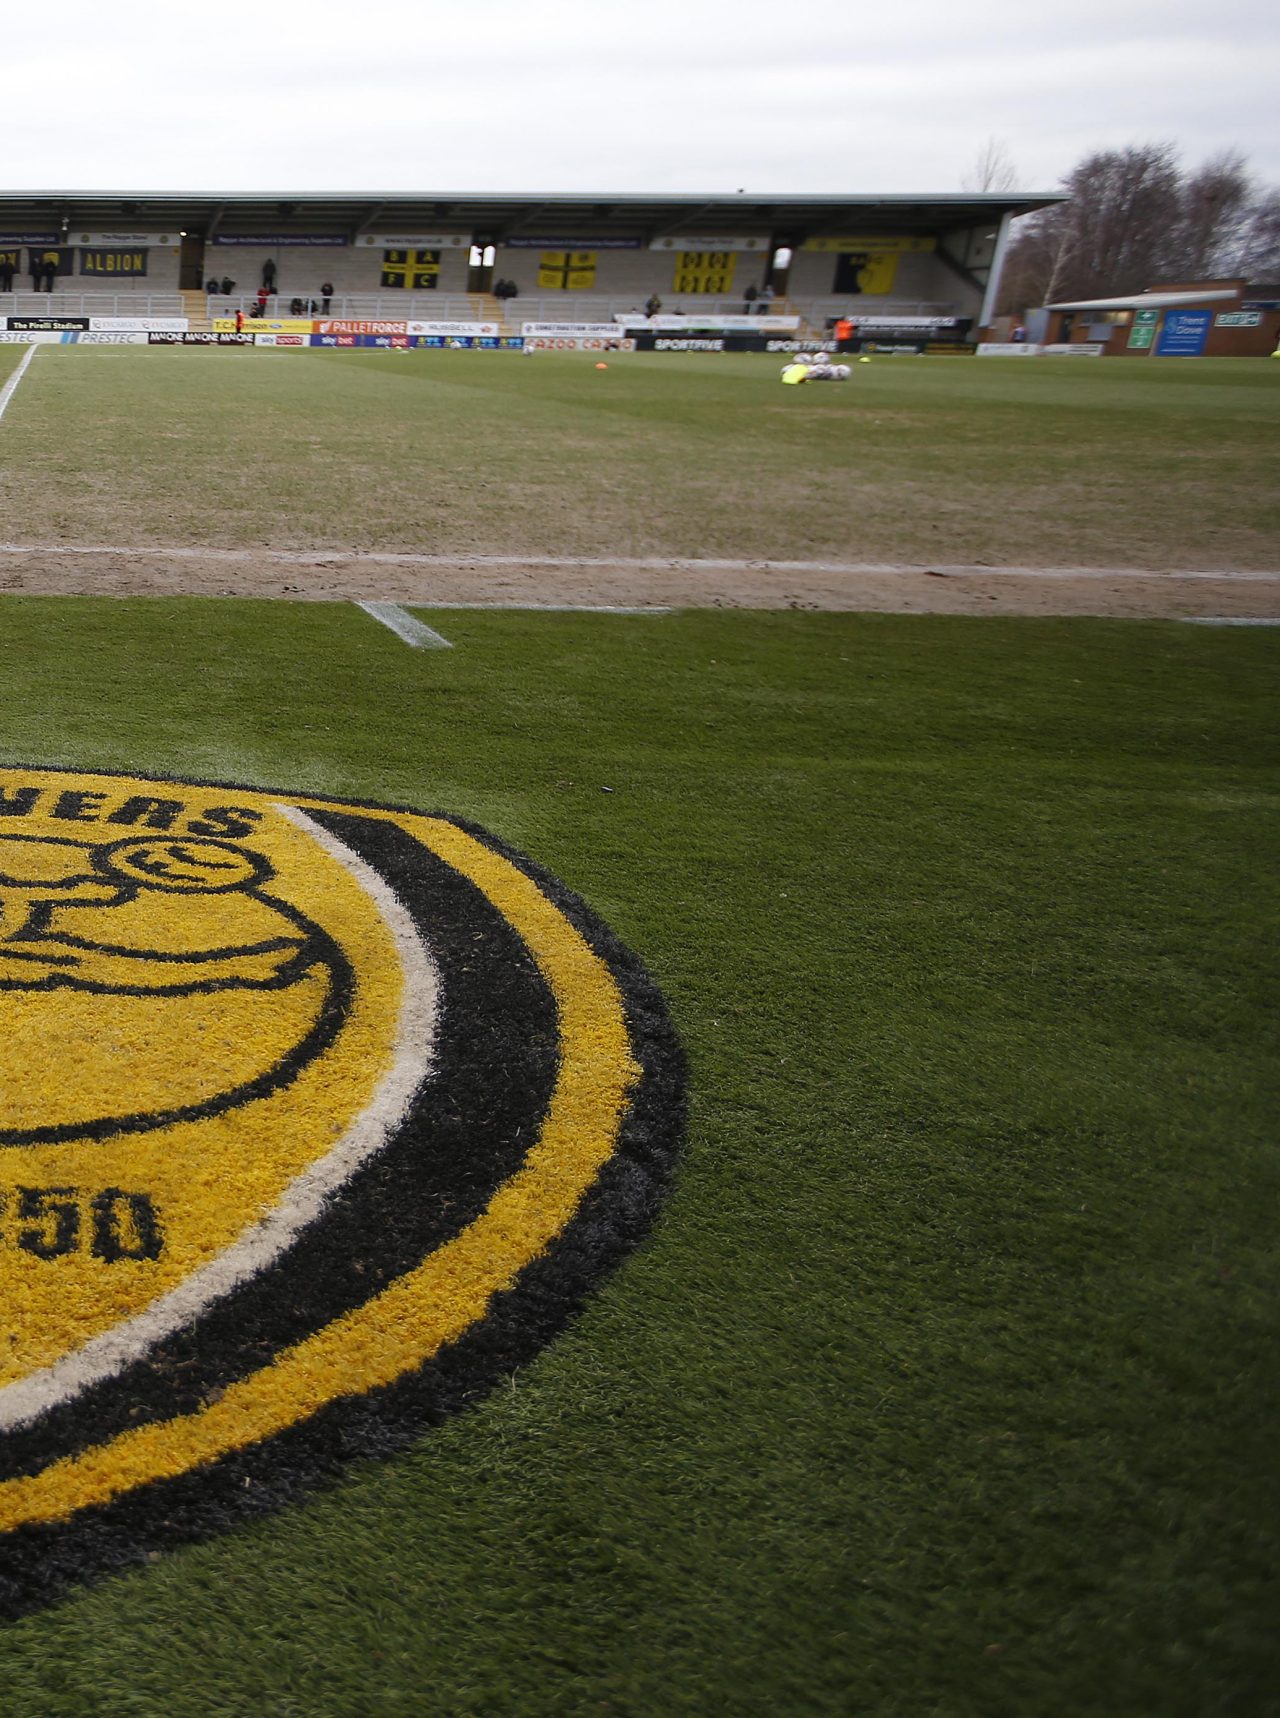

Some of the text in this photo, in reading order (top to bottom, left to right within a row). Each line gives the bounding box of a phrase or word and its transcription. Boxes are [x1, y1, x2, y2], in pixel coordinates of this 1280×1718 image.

[85, 253, 142, 271] ALBION
[13, 321, 84, 330] The Pirelli Stadium
[333, 321, 406, 333] PALLETFORCE
[81, 333, 136, 344] PRESTEC
[321, 336, 354, 346] sky bet
